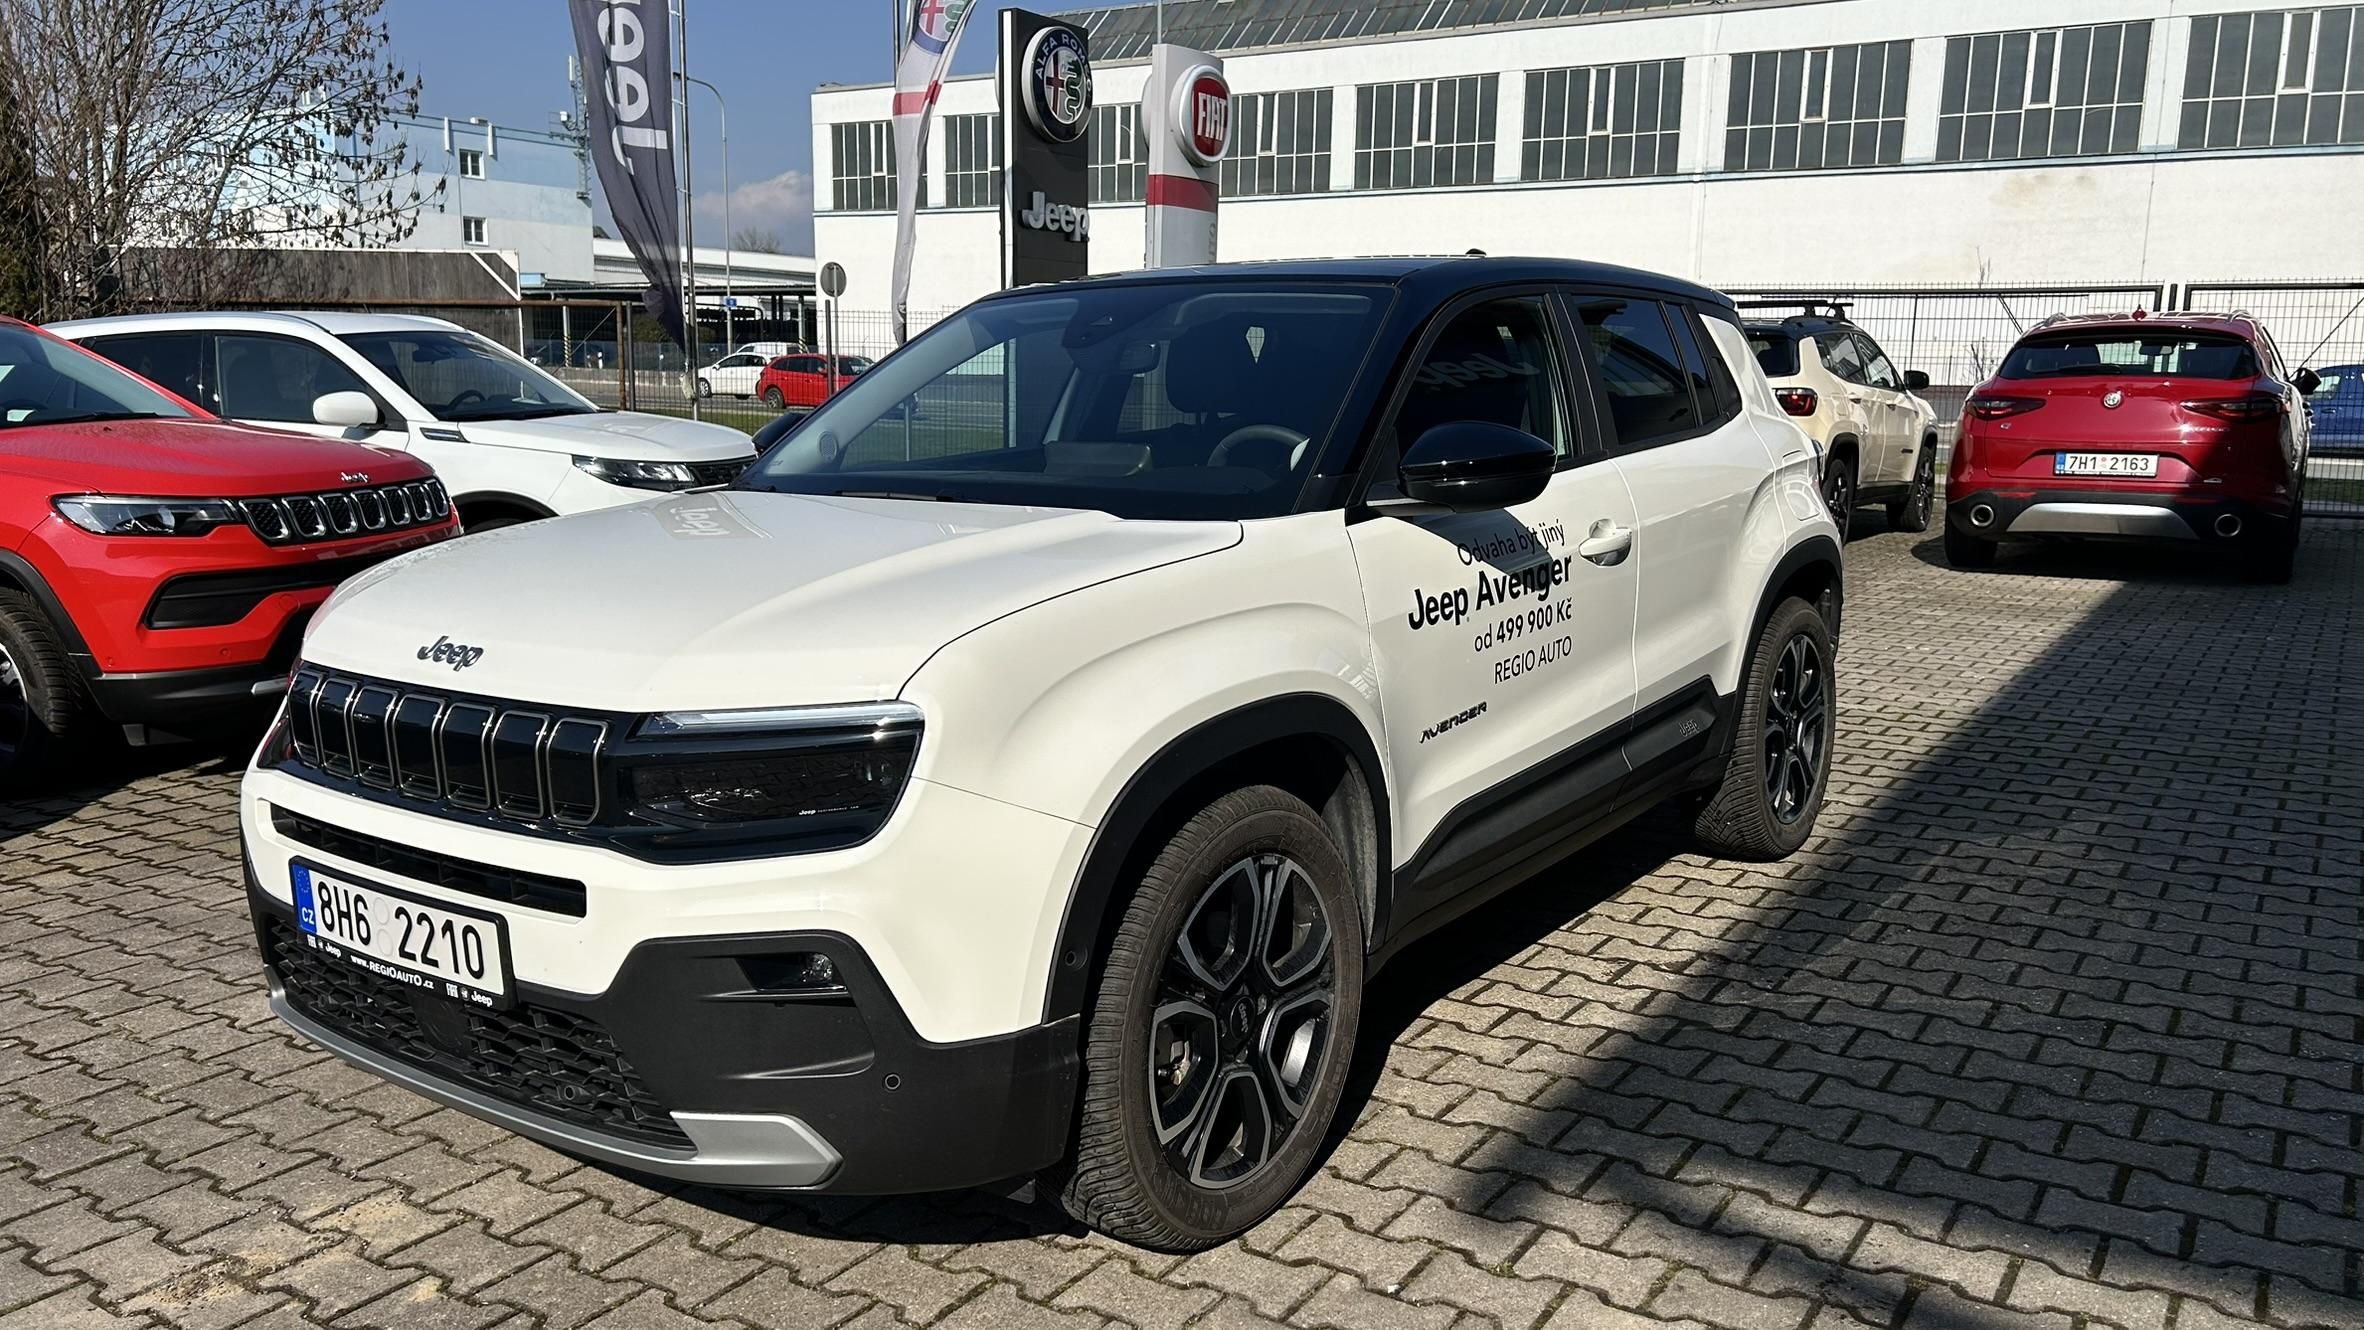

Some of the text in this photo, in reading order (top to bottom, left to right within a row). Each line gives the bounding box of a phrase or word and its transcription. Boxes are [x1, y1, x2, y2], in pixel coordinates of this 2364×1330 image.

[1035, 33, 1092, 92] ALFA ROMEO
[1197, 92, 1227, 141] FIAT
[1021, 191, 1089, 241] Jeep
[2069, 456, 2150, 471] 7H1 2163
[1457, 518, 1565, 566] Odvaha být jiný
[1408, 554, 1573, 630] Jeep Avenger
[1474, 597, 1573, 651] od 499 900 Kč
[417, 634, 484, 671] Jeep
[1494, 636, 1573, 684] REGIO AUTO
[1419, 701, 1487, 743] AVENGER
[301, 906, 315, 925] CZ
[317, 881, 486, 980] 8H6 2210
[471, 990, 493, 1007] Jeep
